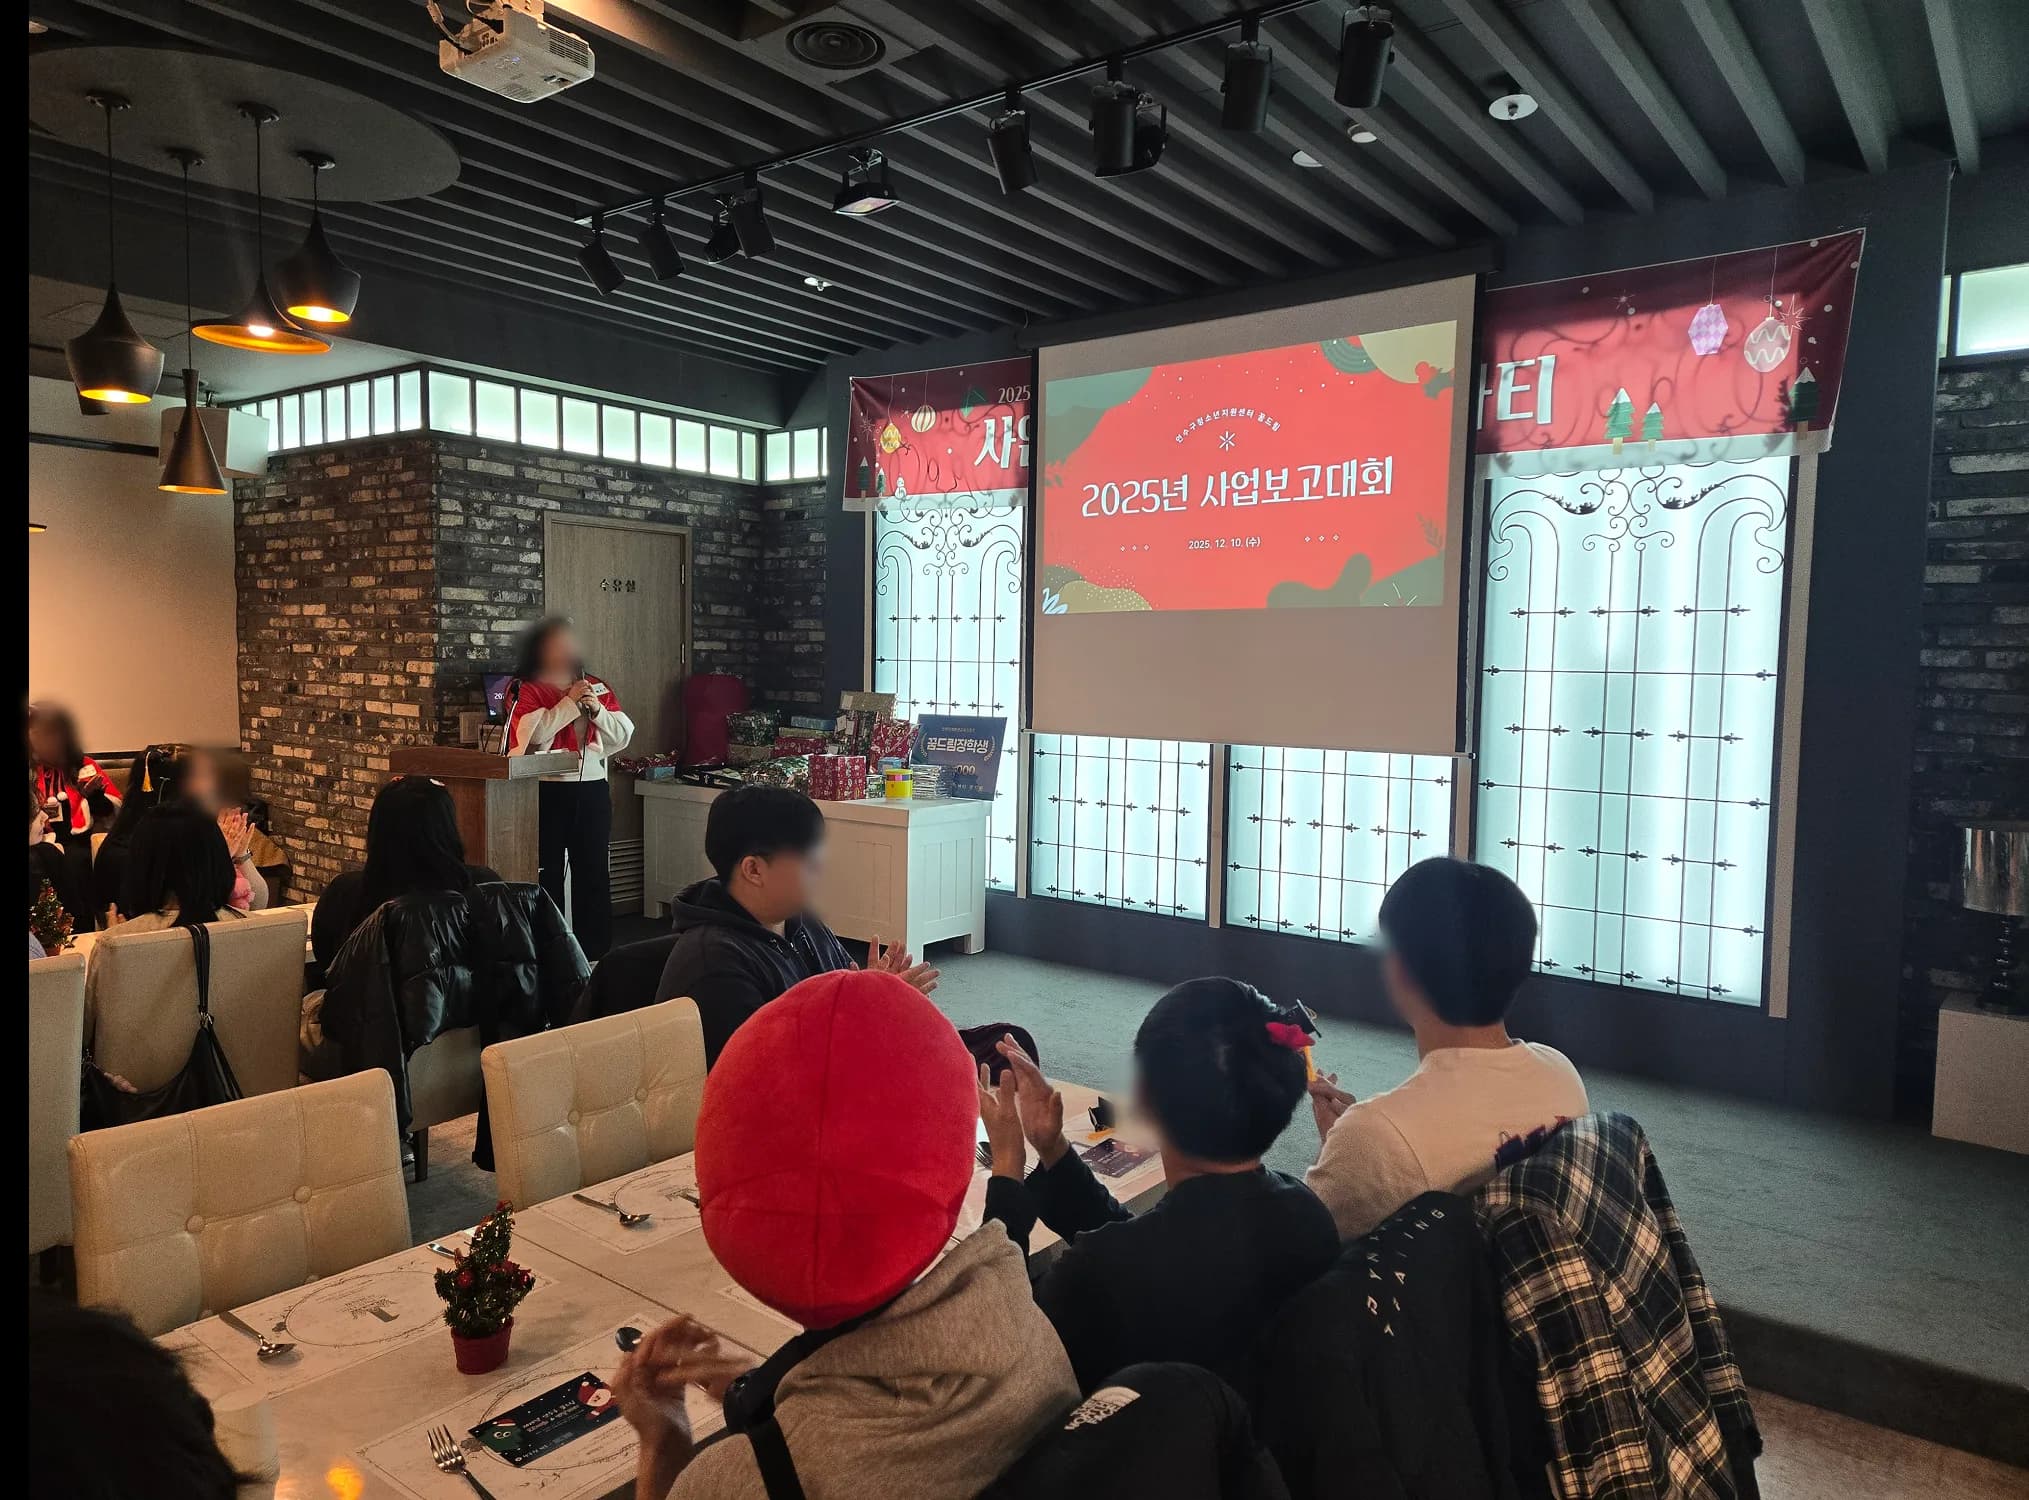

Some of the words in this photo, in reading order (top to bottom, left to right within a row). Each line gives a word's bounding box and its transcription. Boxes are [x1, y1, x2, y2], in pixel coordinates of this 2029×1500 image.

[998, 385, 1031, 403] 2025
[1257, 412, 1281, 432] 꿈드림
[1081, 474, 1188, 518] 2025년
[1200, 456, 1393, 508] 사업보고대회
[1245, 536, 1261, 548] (수)
[926, 737, 989, 754] 꿈드림장학생
